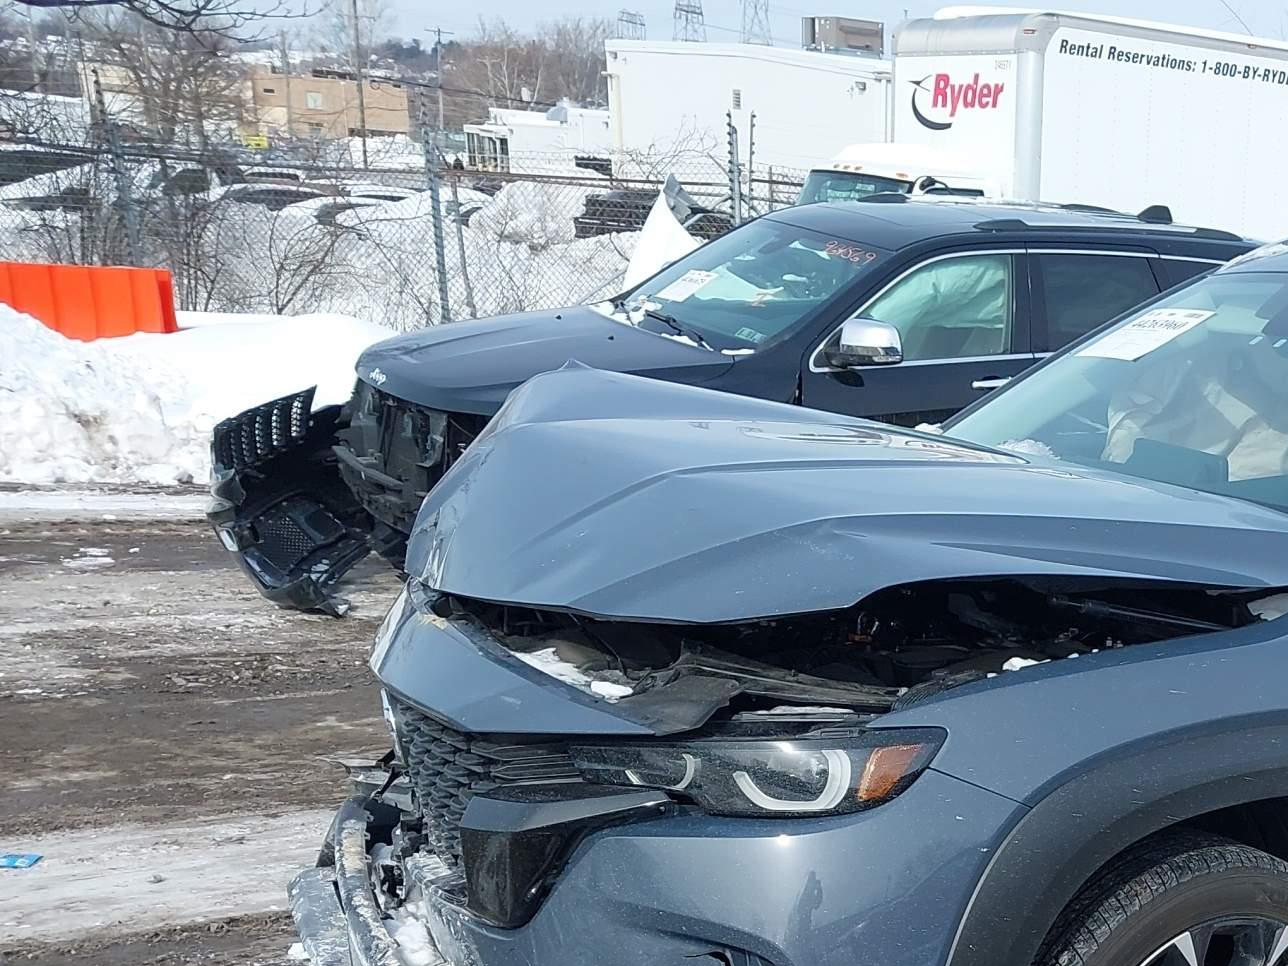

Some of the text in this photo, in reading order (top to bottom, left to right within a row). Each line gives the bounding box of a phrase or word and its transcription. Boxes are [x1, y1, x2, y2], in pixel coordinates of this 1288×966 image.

[1059, 39, 1104, 59] Rental
[1107, 46, 1197, 73] Reservations:
[931, 72, 1005, 118] Ryder
